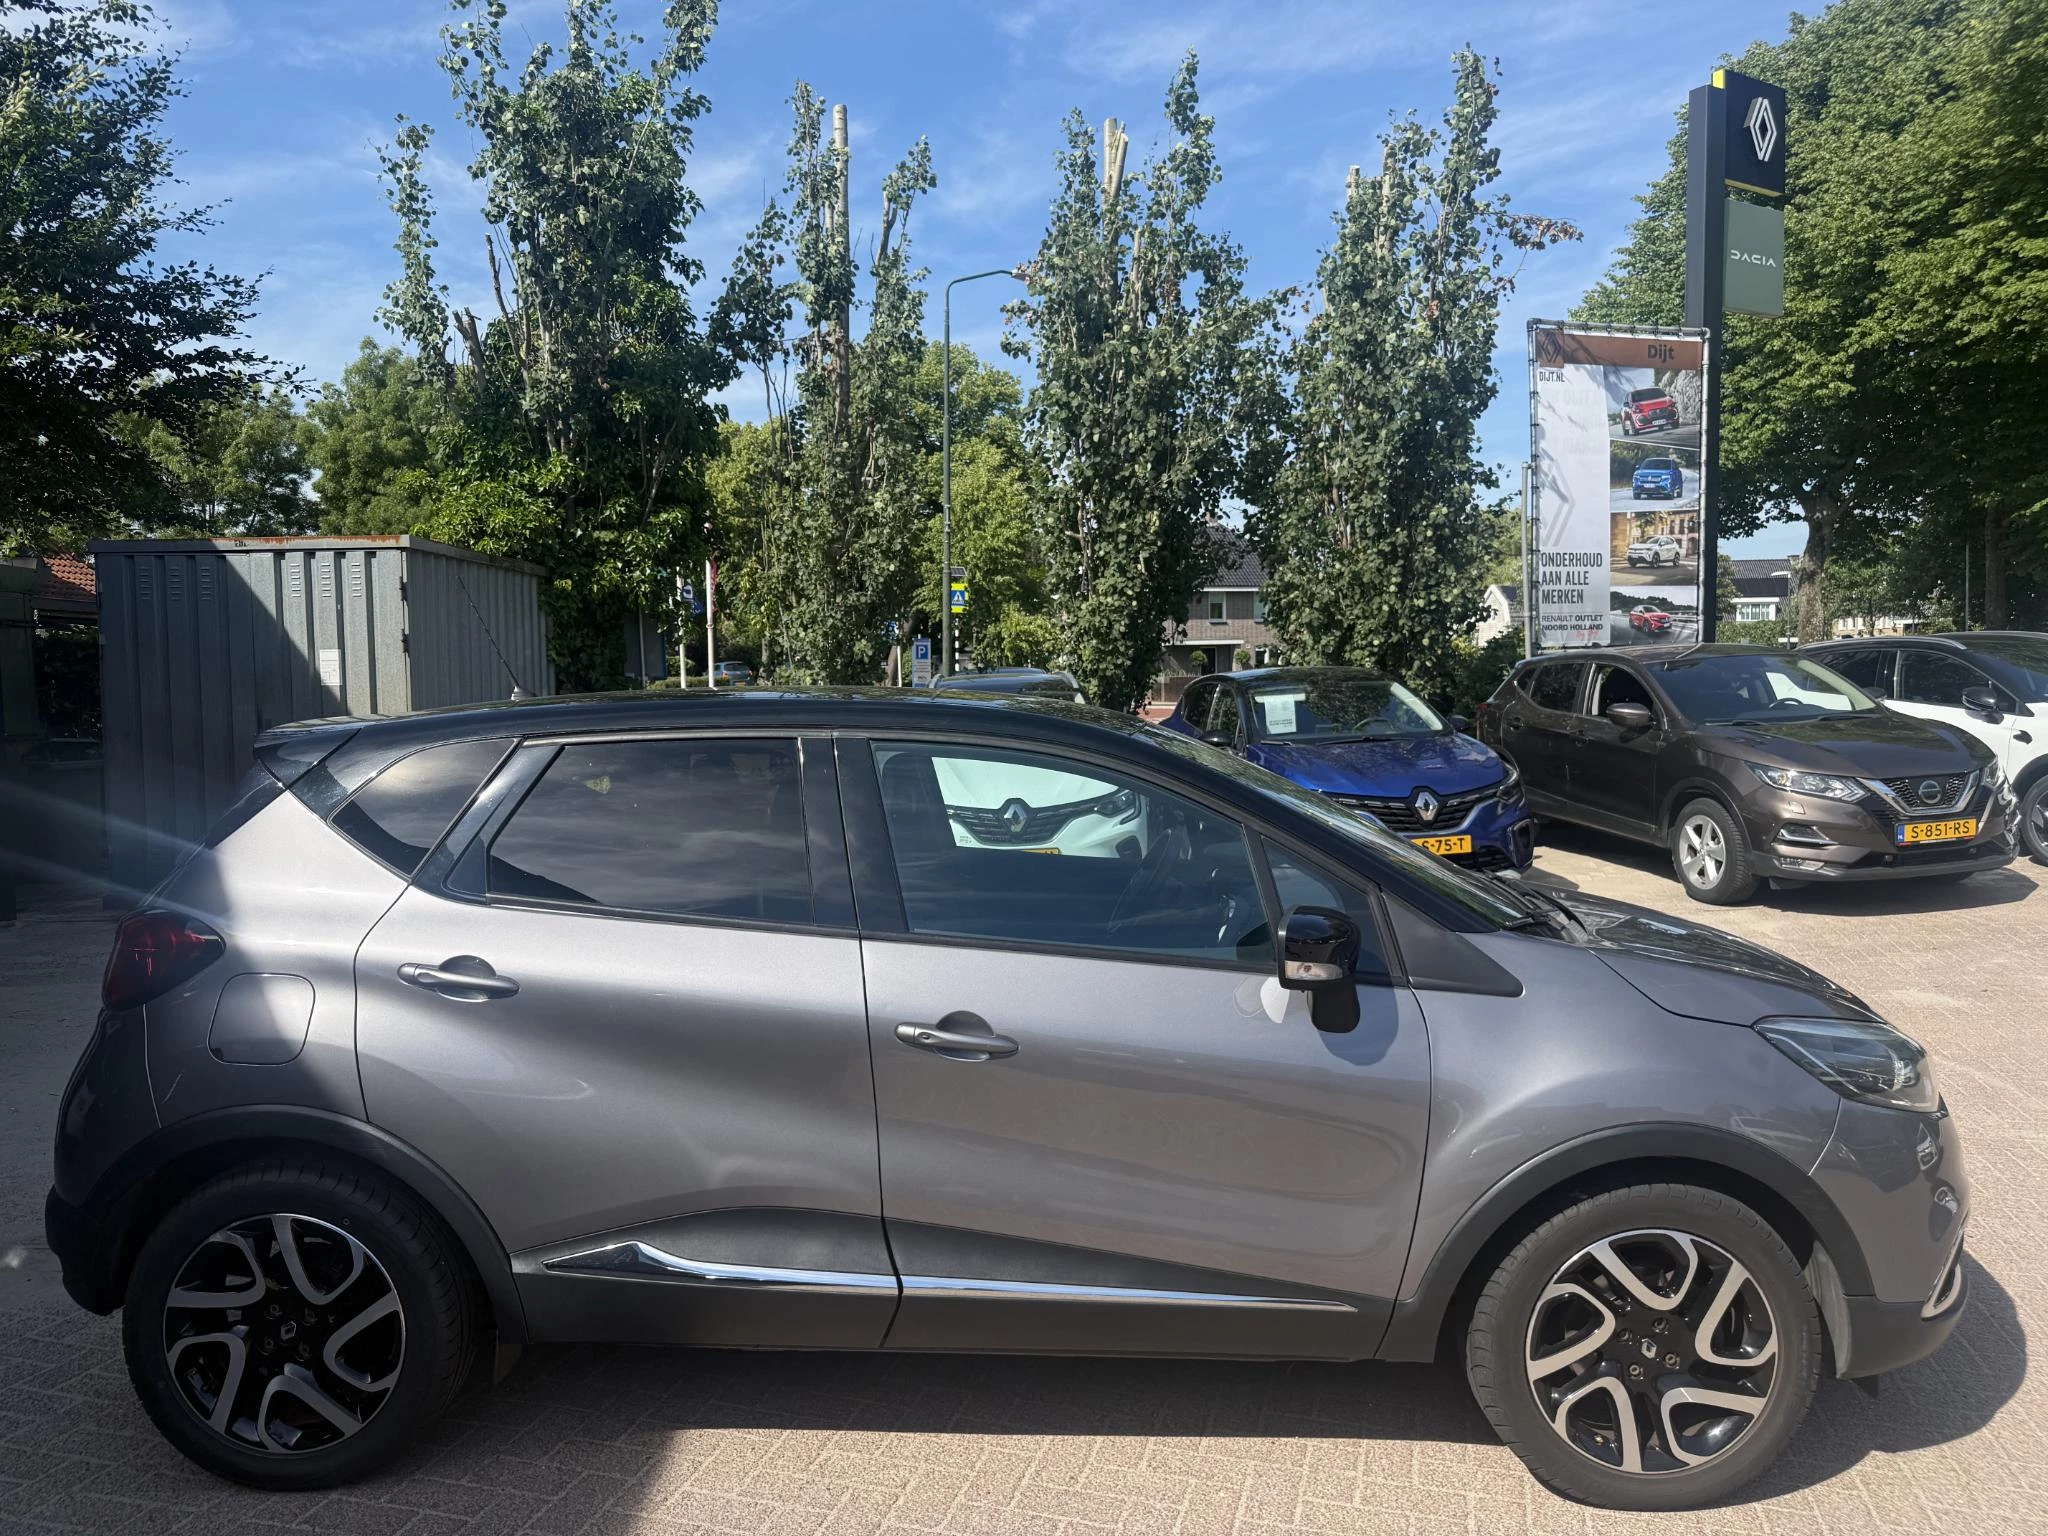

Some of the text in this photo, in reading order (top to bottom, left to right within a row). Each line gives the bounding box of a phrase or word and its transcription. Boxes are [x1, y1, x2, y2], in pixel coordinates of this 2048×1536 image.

[1730, 249, 1776, 267] DACIA
[1647, 344, 1675, 363] Dijt
[1539, 371, 1565, 383] DIJT.NL
[1541, 552, 1603, 567] ONDERHOUD
[1541, 571, 1589, 586] AAN ALLE
[1541, 589, 1584, 604] MERKEN
[1574, 614, 1604, 622] OUTLET
[918, 646, 926, 658] P
[1911, 821, 1970, 839] S-851-RS
